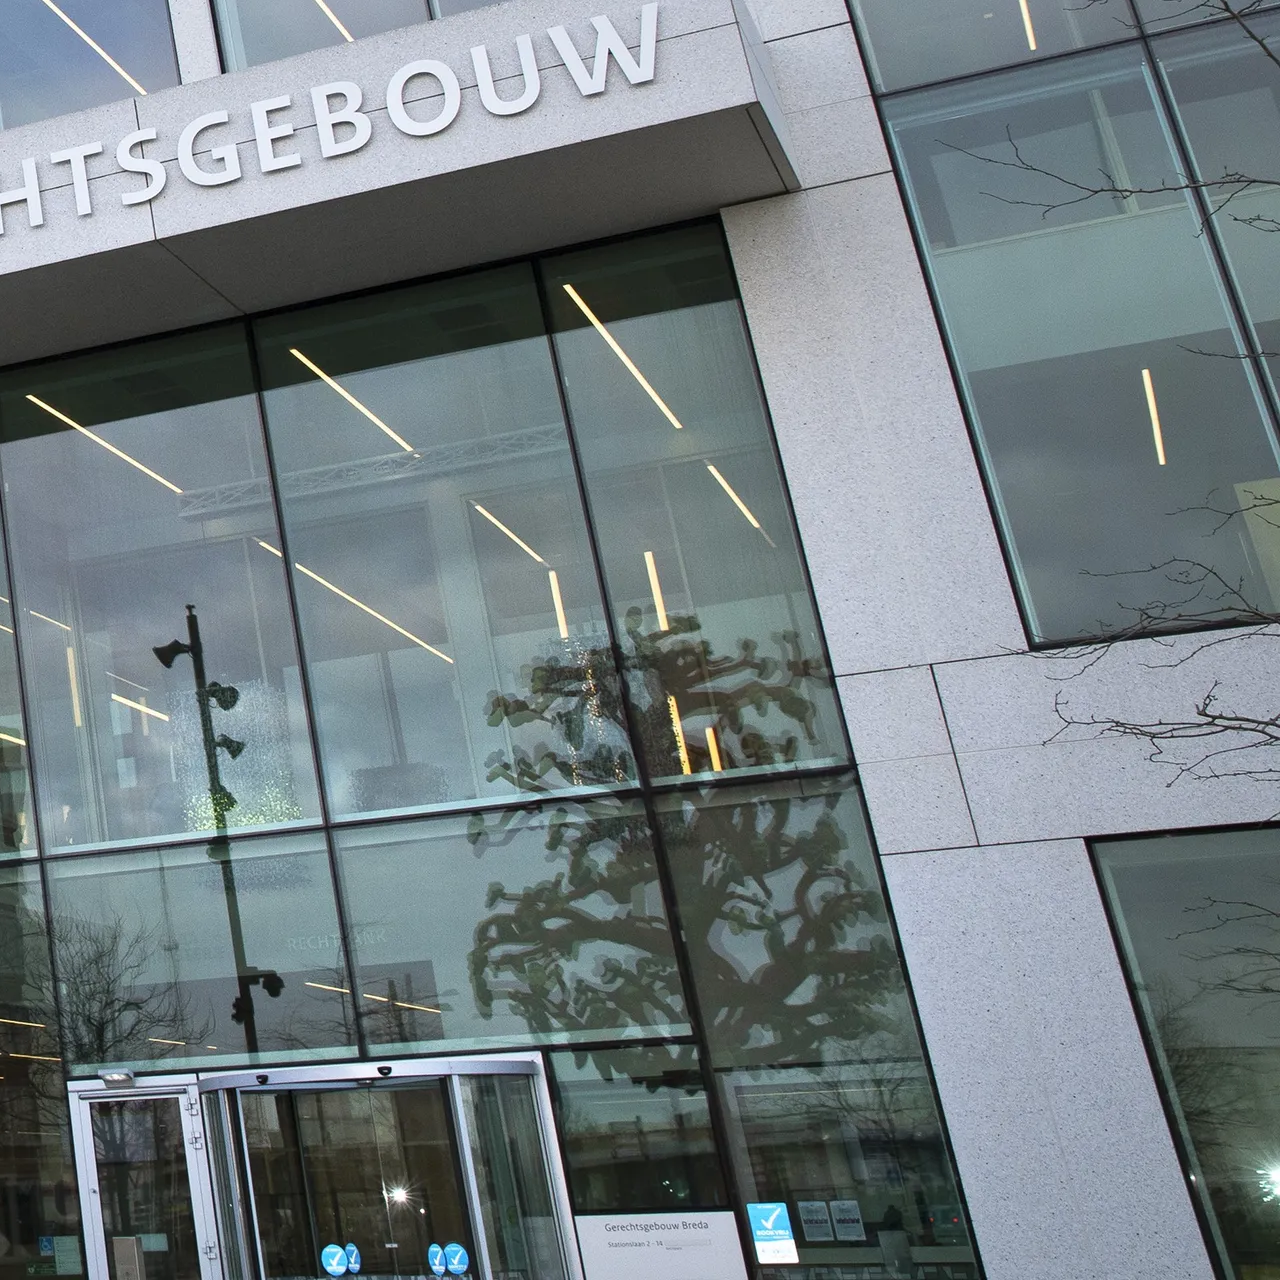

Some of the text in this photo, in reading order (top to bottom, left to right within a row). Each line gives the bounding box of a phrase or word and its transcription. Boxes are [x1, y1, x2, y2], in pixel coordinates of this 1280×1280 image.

[289, 929, 387, 951] RECHTANK
[604, 1221, 709, 1233] Gerechtsgebouw Breda
